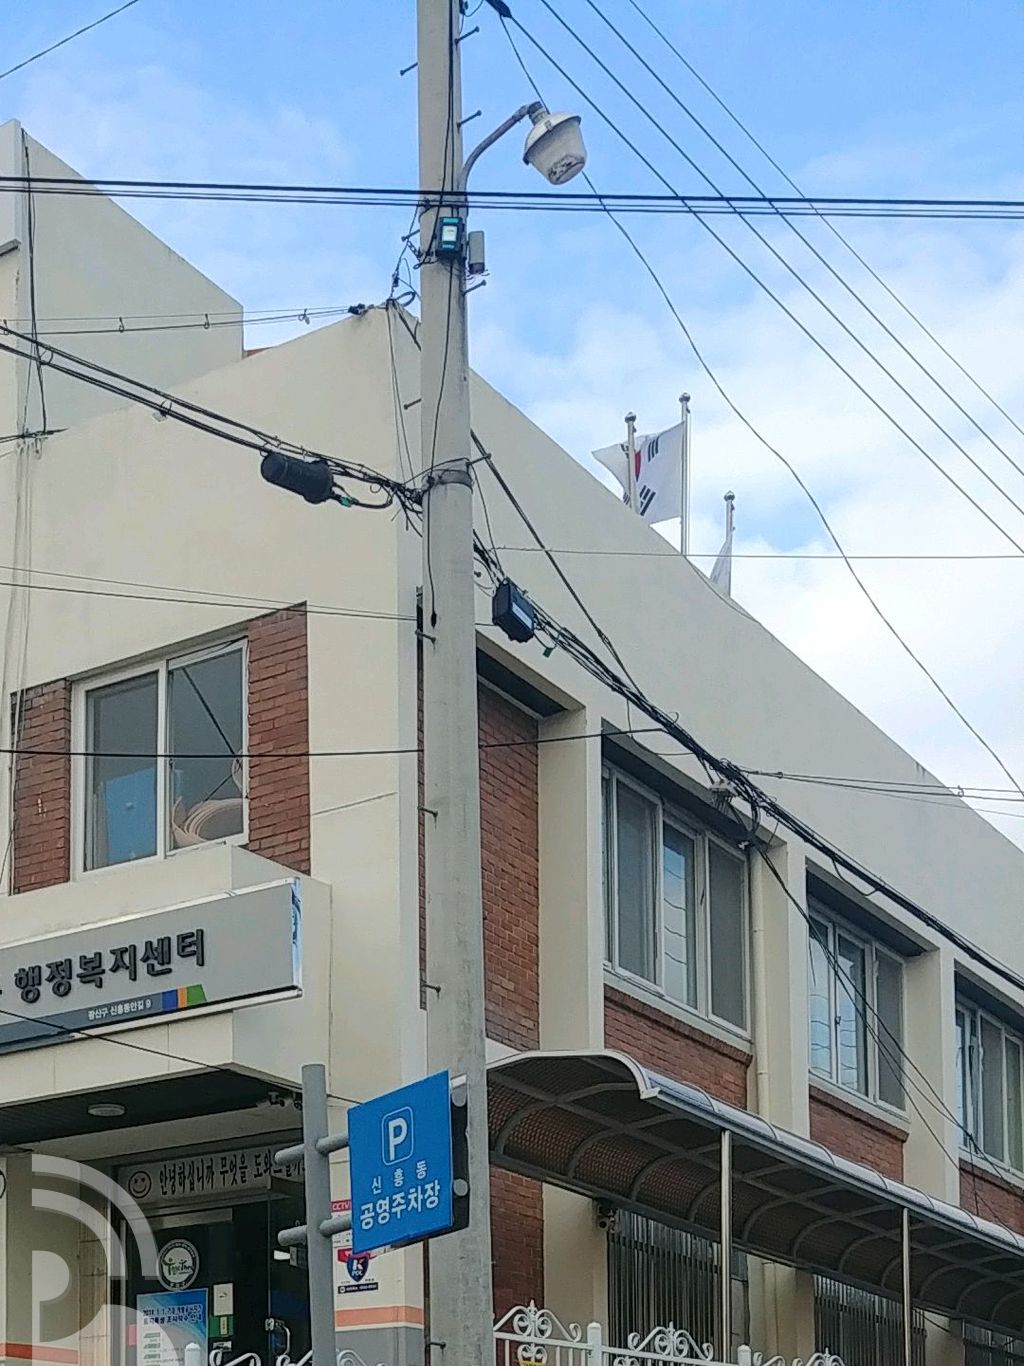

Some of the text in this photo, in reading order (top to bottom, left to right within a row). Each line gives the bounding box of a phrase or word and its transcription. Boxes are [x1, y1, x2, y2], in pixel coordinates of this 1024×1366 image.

[14, 928, 206, 1004] 행정복지센터
[388, 1117, 408, 1161] P
[159, 1157, 215, 1196] 안녕하십니까
[219, 1152, 248, 1187] 무엇을
[332, 1202, 350, 1211] CCTV
[359, 1179, 441, 1231] 공영주차장
